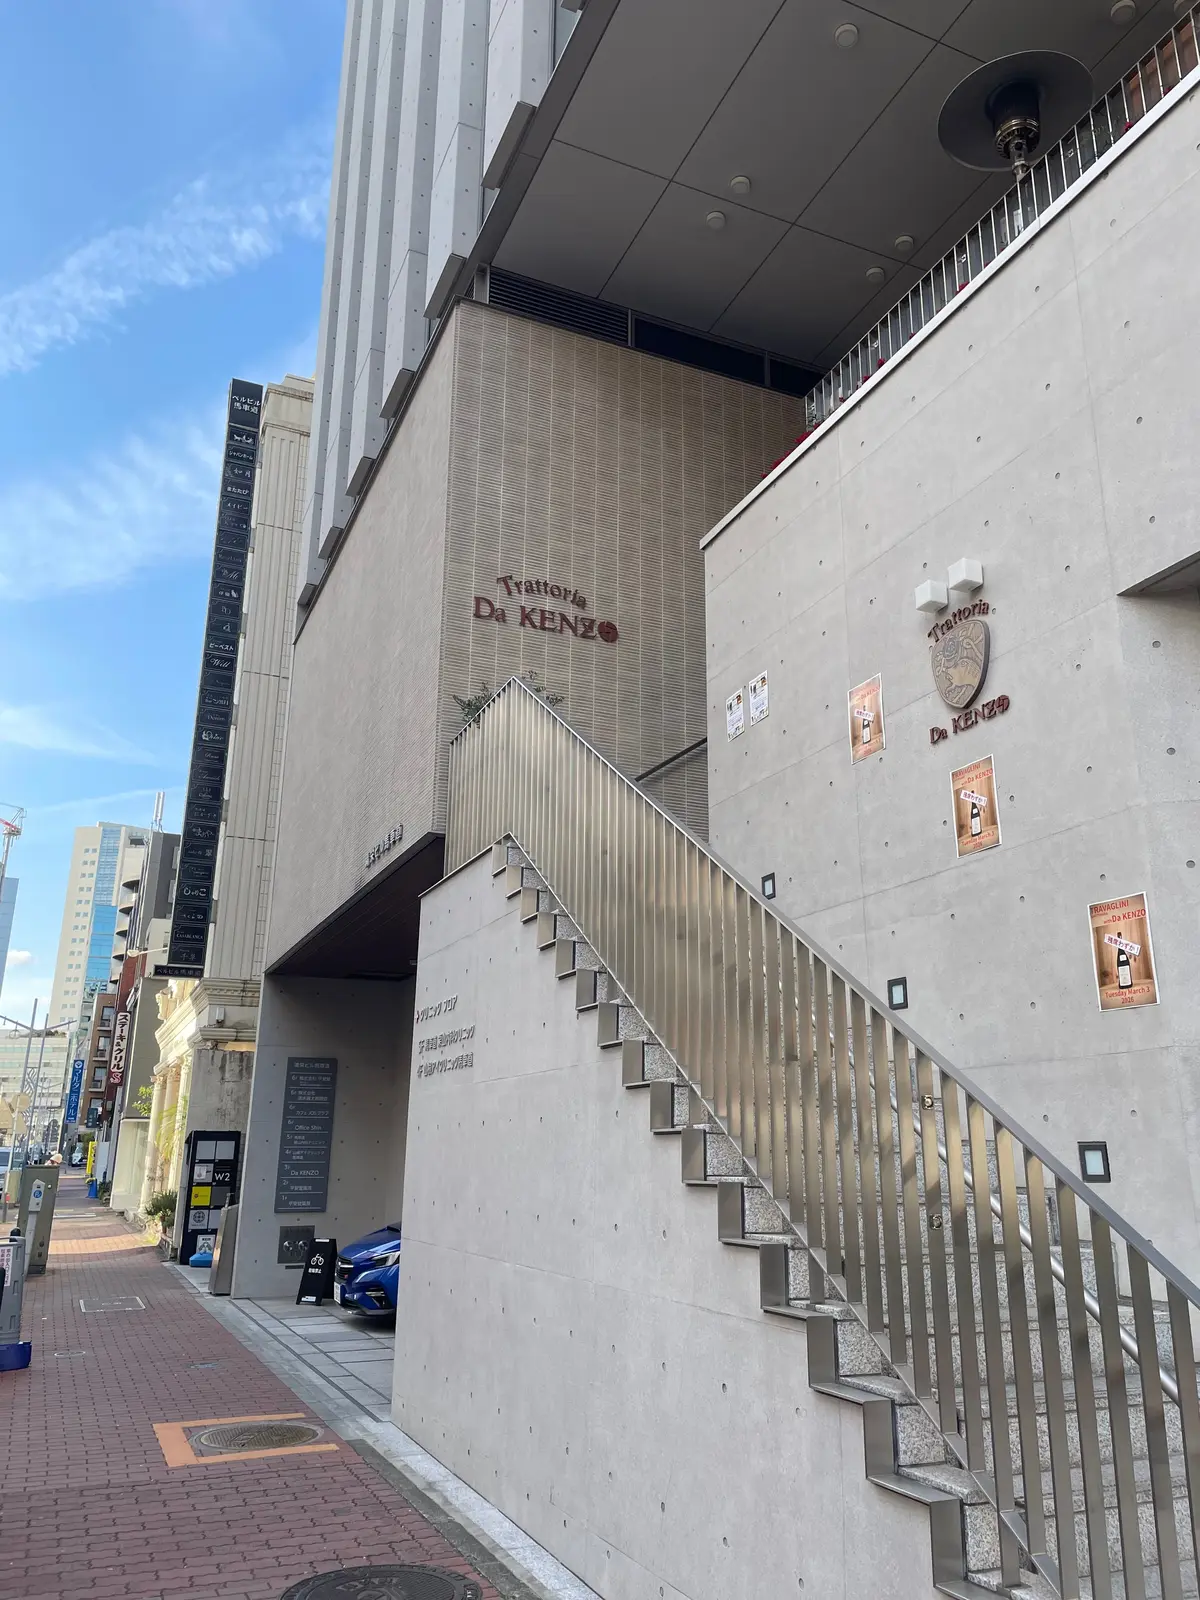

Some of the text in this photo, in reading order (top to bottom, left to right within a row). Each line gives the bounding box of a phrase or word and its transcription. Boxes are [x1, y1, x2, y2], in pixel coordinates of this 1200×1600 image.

[232, 395, 261, 406] ベルビル
[234, 402, 259, 414] 馬車道
[496, 574, 588, 610] Trattoria
[473, 596, 619, 644] Da KENZO
[928, 599, 990, 642] Trattoria
[929, 694, 1010, 745] Da KENZO
[968, 776, 974, 784] Da
[975, 768, 993, 780] KENZO
[978, 834, 992, 842] March
[1090, 900, 1130, 915] TRAVAGLINI
[1112, 914, 1122, 922] Da
[1122, 908, 1146, 920] KENZO
[1105, 990, 1128, 998] Tuesday
[420, 994, 458, 1022] クリニック フロア
[68, 1069, 84, 1117] マルタニホテル
[214, 1172, 230, 1182] W2
